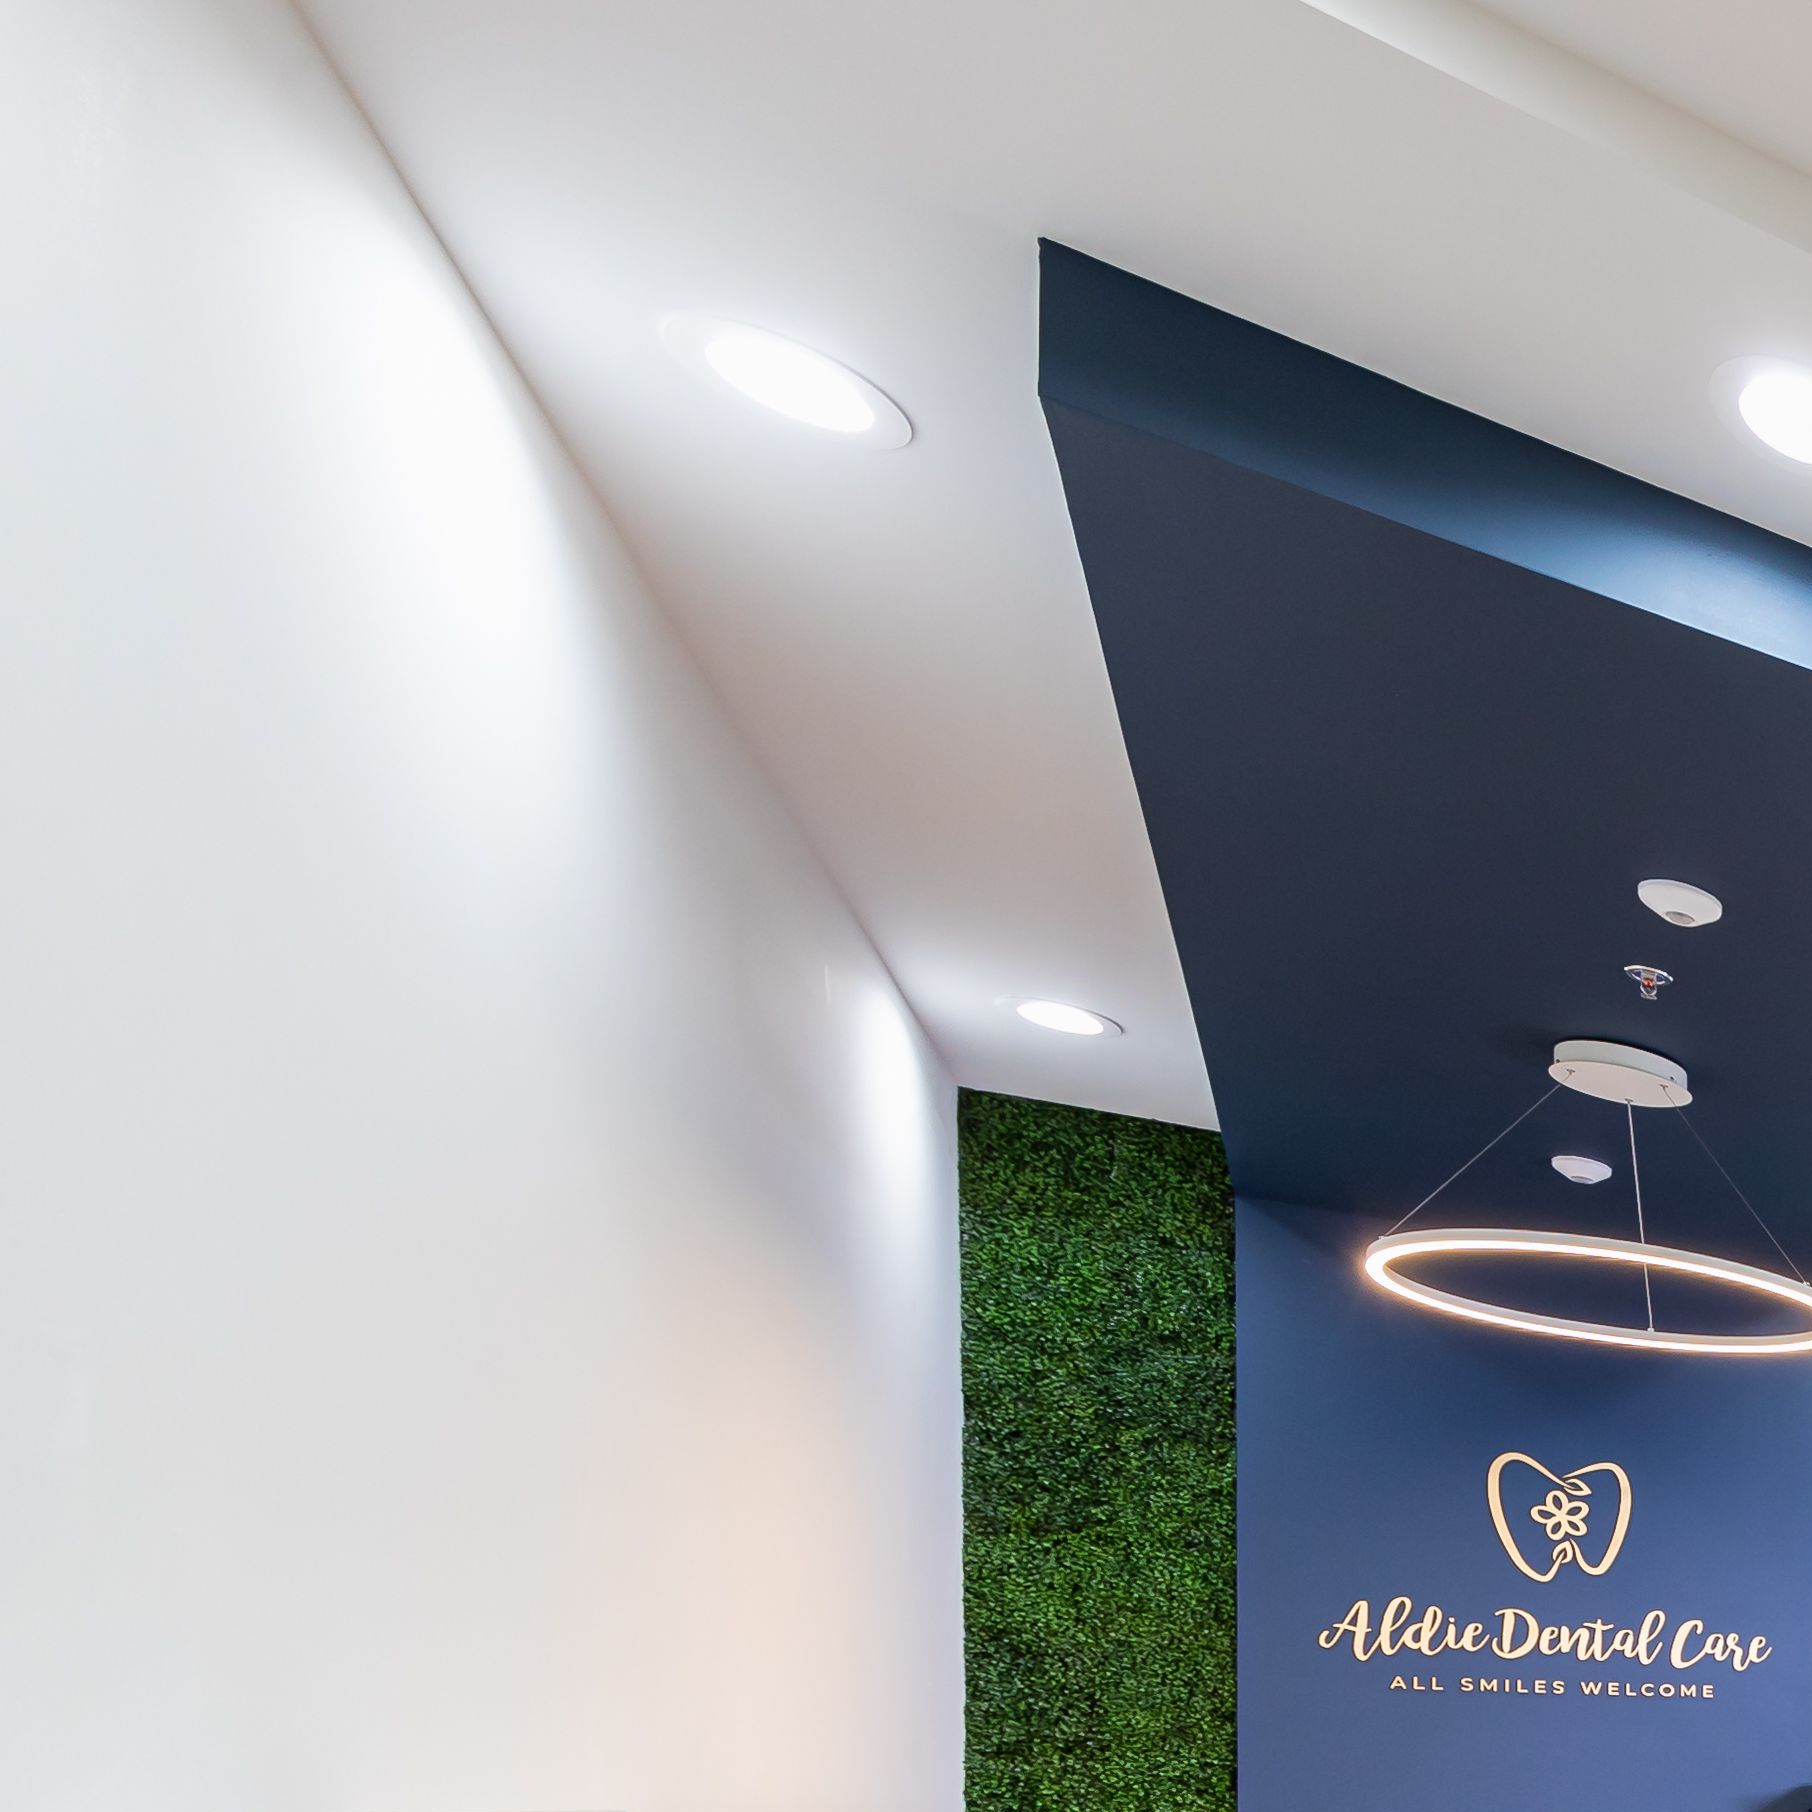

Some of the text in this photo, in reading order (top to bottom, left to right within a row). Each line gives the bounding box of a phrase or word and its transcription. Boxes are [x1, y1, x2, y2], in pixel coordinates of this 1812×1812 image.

[1318, 1596, 1773, 1672] Aldie Dental Care
[1389, 1675, 1715, 1699] ALL SMILES WELCOME
